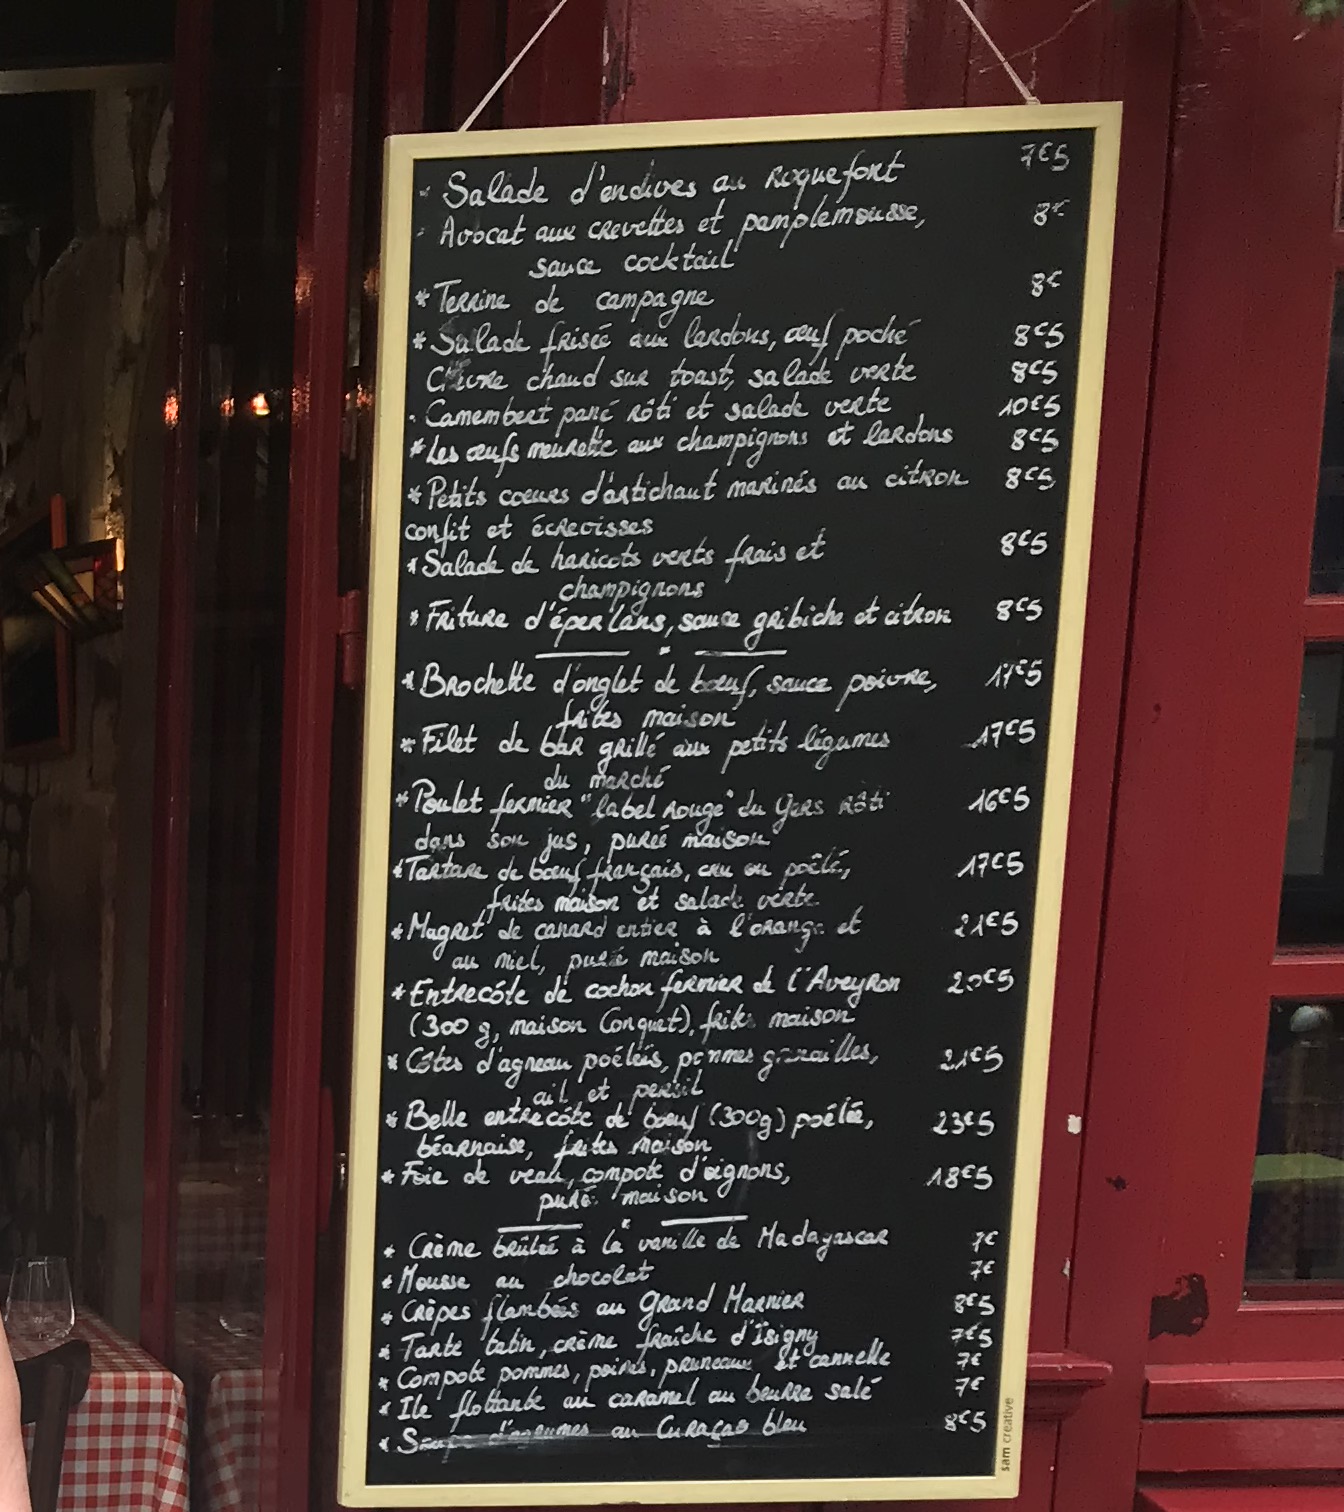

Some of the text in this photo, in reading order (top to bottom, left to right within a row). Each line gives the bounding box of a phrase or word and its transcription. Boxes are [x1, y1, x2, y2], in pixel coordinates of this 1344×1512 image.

[443, 167, 548, 209] Salade
[570, 160, 696, 207] d'endives
[713, 175, 746, 193] au
[440, 194, 925, 252] Avocat aux crevettes et pamplemousse,
[529, 239, 736, 278] sauce cocktail
[434, 279, 714, 329] Terrine de campagne
[430, 313, 921, 373] Salade frisée aux lardons, poché
[526, 353, 916, 392] chaud sur toast, salade verte
[426, 396, 553, 427] Camembert
[556, 400, 620, 439] pané
[686, 391, 714, 420] et
[725, 390, 809, 421] salade
[825, 387, 891, 417] verte
[424, 412, 953, 468] Les aux champignons et lardons
[427, 459, 969, 510] Petits marinés au citron
[405, 513, 513, 560] confit et
[422, 528, 826, 583] Salade de haricots verts frais et
[557, 575, 706, 617] champignons
[425, 593, 951, 651] Friture sauce gribiche et citron
[419, 661, 937, 712] Brochette de sauce poivre,
[555, 697, 738, 739] frites maison
[422, 719, 890, 775] Filet de bar grillé aux petits légumes
[544, 763, 671, 790] du marché
[412, 778, 766, 832] Poulet fermier du
[415, 823, 770, 865] dans son purée maison
[405, 852, 772, 897] Tartare de français, cru ou
[487, 884, 659, 926] frites maison et
[407, 909, 489, 962] Magret
[498, 918, 523, 940] de
[534, 916, 607, 940] canard
[697, 917, 711, 935] à
[837, 906, 863, 934] et
[452, 942, 719, 977] au miel, maison
[544, 969, 744, 1014] de cochon fermier
[410, 1006, 855, 1037] (300 maison maison
[477, 1045, 572, 1090] d'agneau
[533, 1077, 610, 1106] ail et
[404, 1099, 468, 1131] Belle
[605, 1102, 631, 1128] de
[416, 1133, 712, 1163] béarnaise, maison
[401, 1160, 448, 1185] Foie
[463, 1159, 490, 1184] de
[581, 1159, 665, 1202] compote
[621, 1186, 708, 1205] maison
[409, 1232, 481, 1259] Crème
[572, 1238, 586, 1254] à
[602, 1229, 623, 1254] la
[717, 1226, 740, 1249] de
[758, 1219, 888, 1261] Madagascar
[397, 1263, 470, 1294] Mousse
[496, 1276, 524, 1289] au
[552, 1259, 654, 1291] chocolat
[596, 1282, 804, 1333] au Grand Marnier
[397, 1358, 485, 1401] Compote
[808, 1336, 890, 1368] cannelle
[401, 1330, 617, 1362] Tarte crème
[397, 1394, 432, 1420] Ile
[449, 1385, 547, 1435] flottante
[563, 1396, 596, 1409] au
[608, 1376, 697, 1408] caramel
[708, 1390, 735, 1403] au
[746, 1373, 813, 1403] beurre
[825, 1376, 882, 1400] salé
[655, 1408, 807, 1441] Curaçao bleu
[1001, 1447, 1011, 1471] sam
